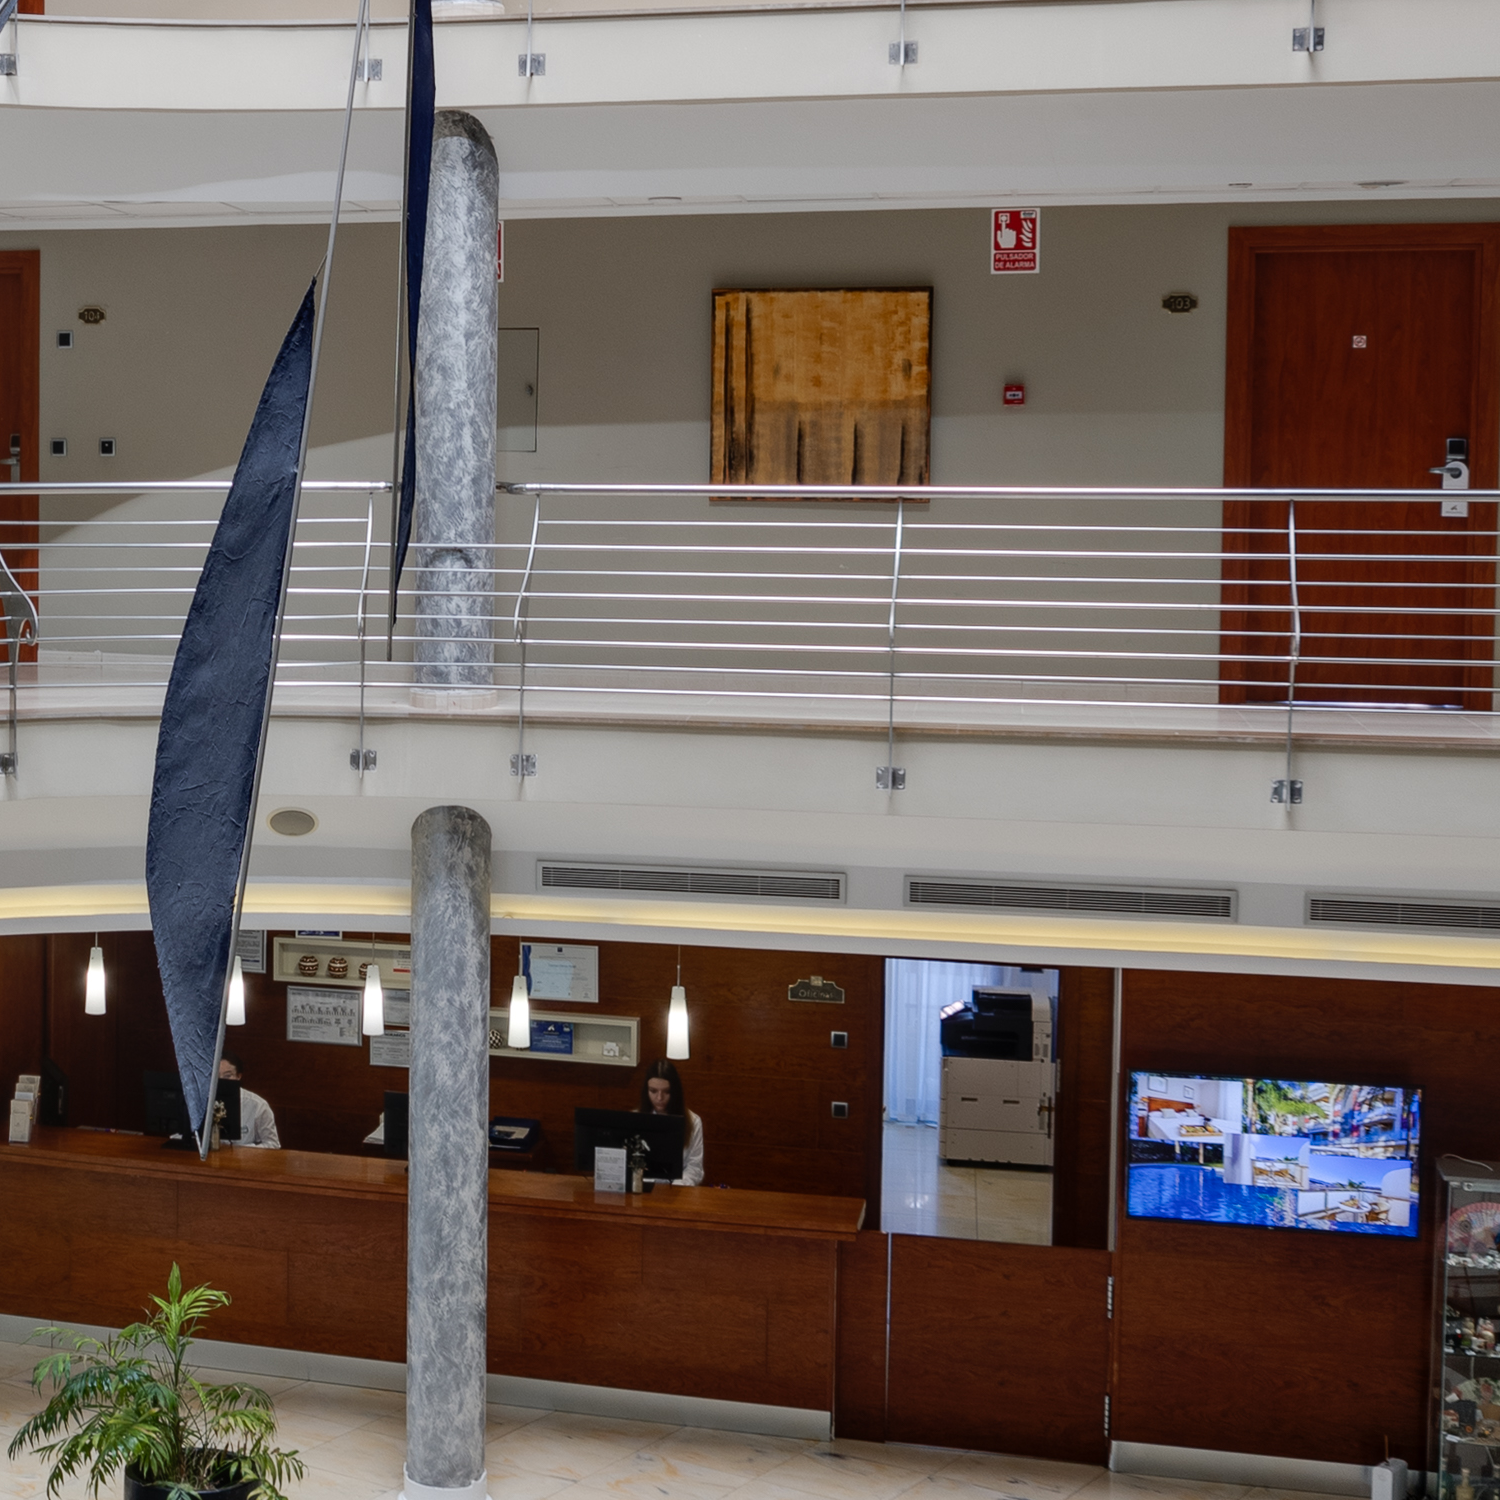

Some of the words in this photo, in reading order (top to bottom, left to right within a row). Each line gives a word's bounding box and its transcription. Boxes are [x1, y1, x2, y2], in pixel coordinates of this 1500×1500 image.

[995, 261, 1004, 269] DE
[1005, 260, 1035, 268] ALARMA
[1170, 297, 1190, 309] 103
[84, 311, 100, 321] 104
